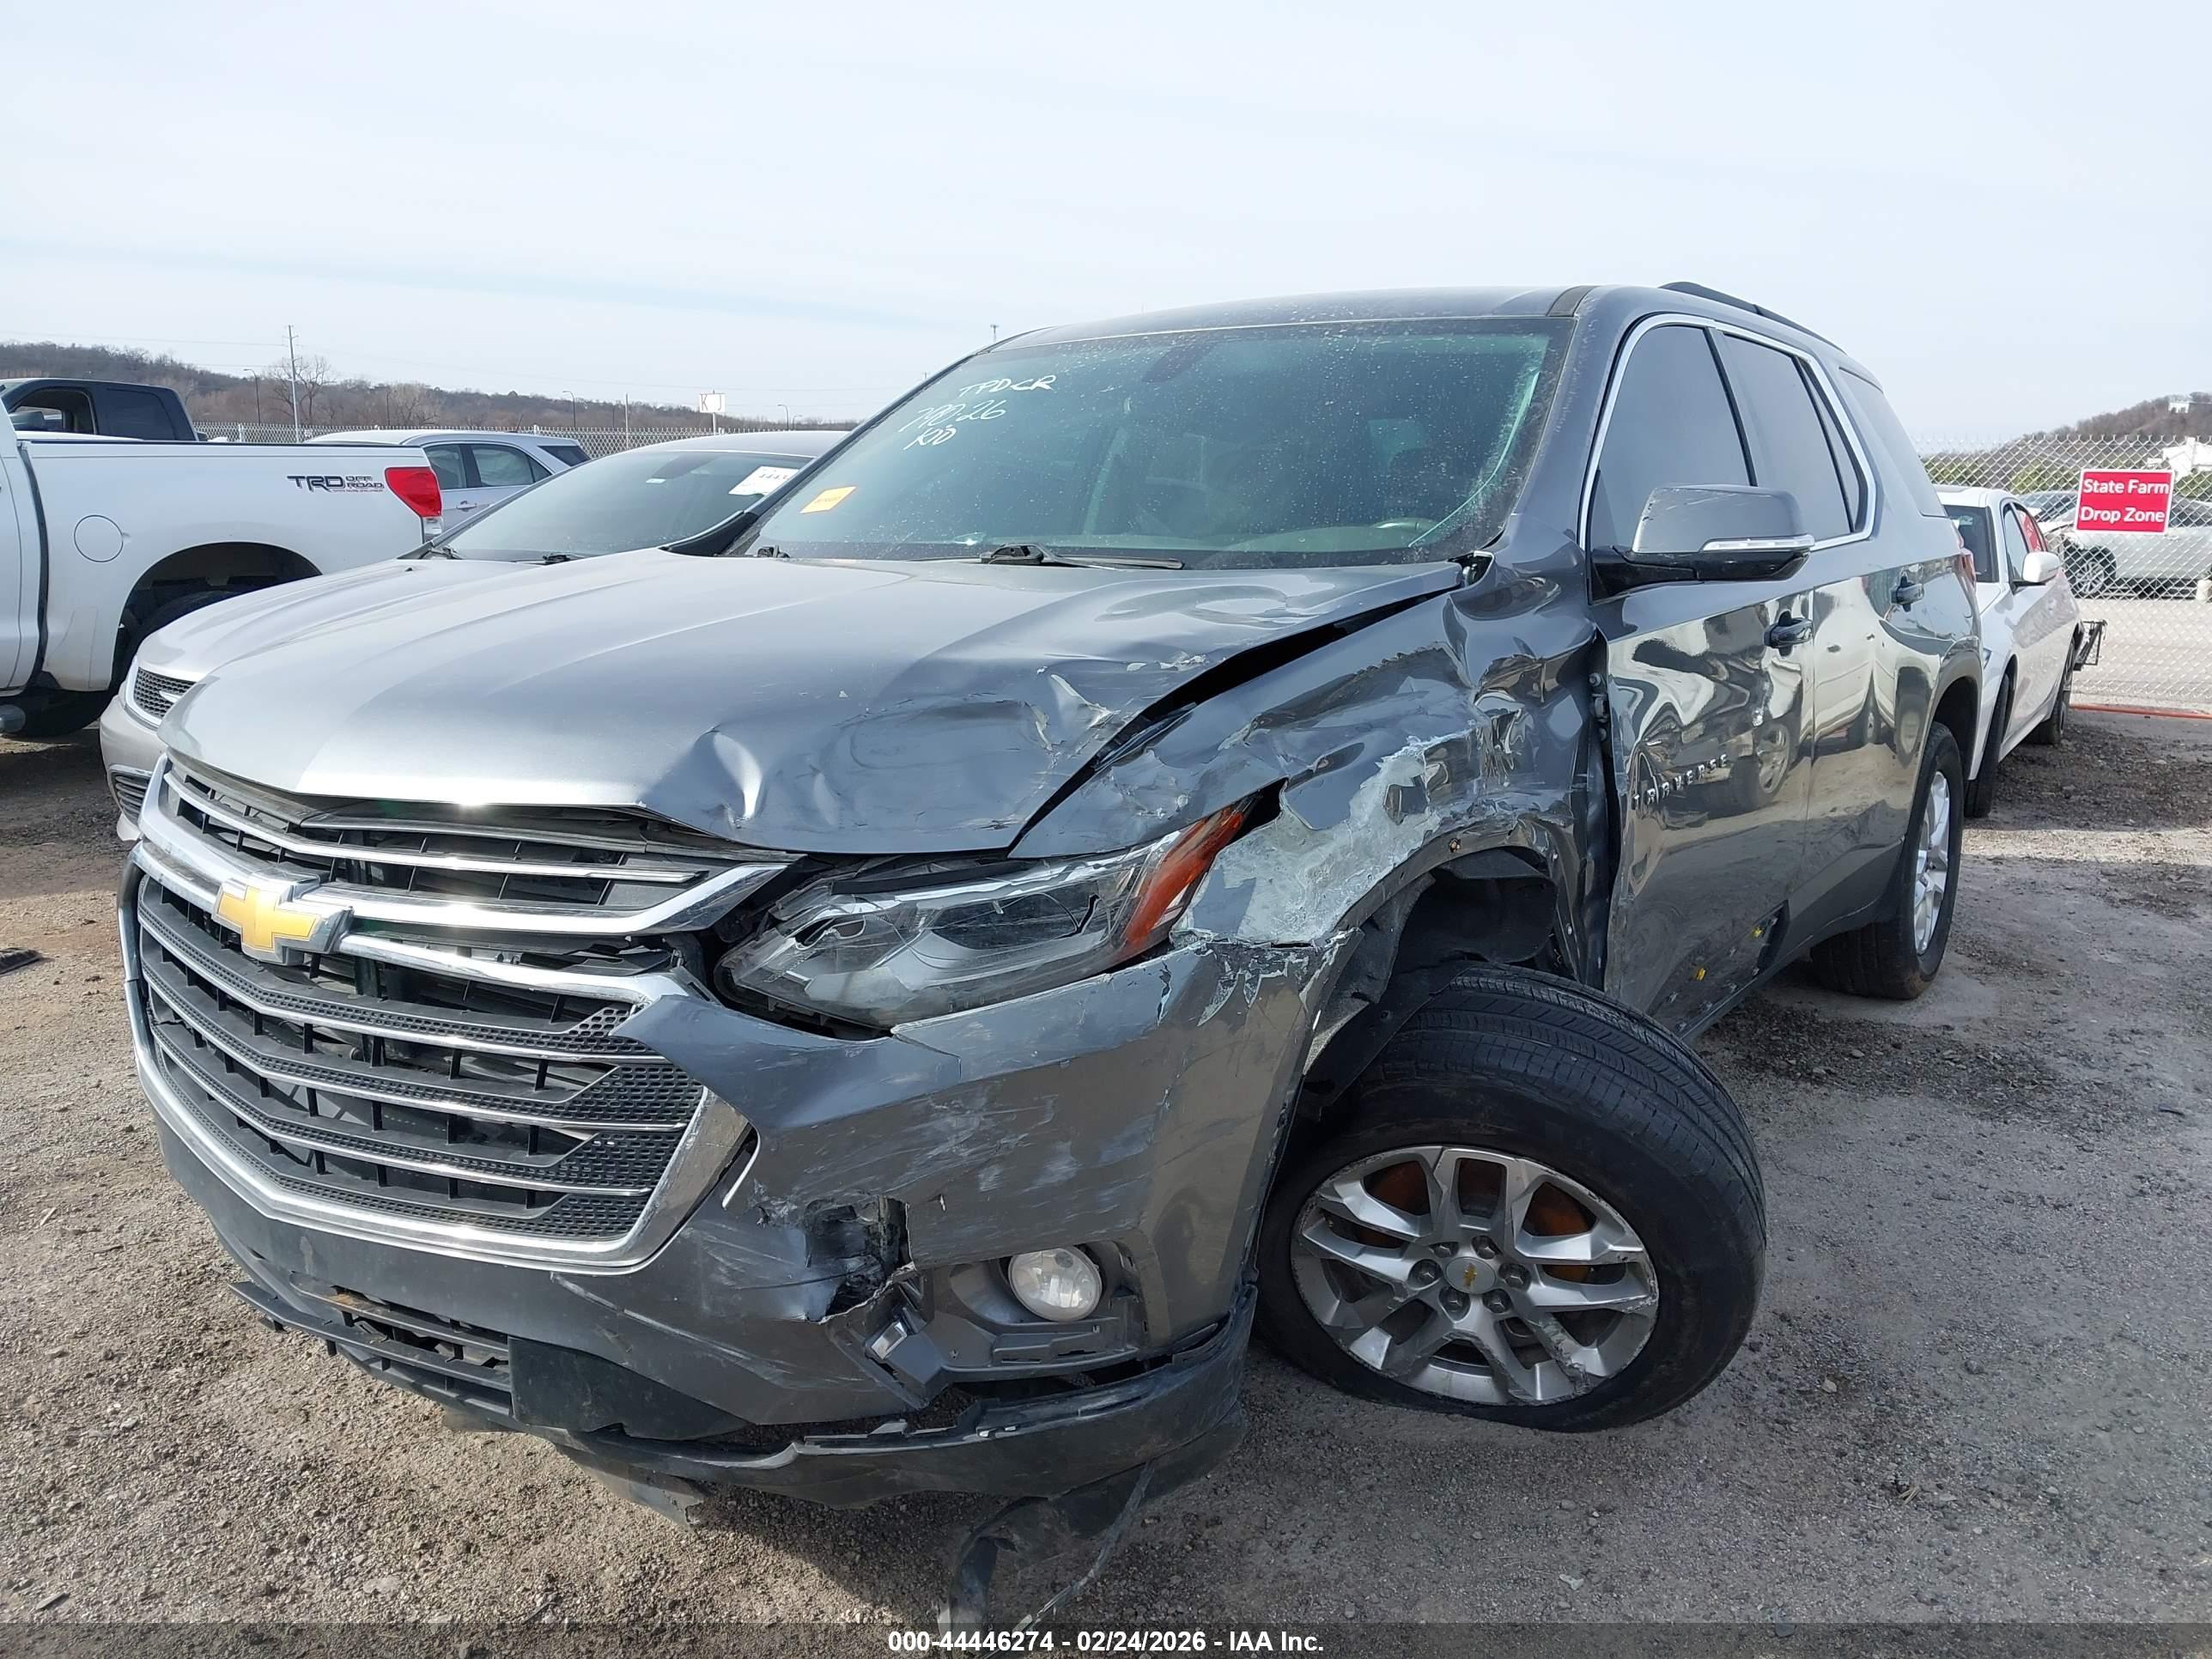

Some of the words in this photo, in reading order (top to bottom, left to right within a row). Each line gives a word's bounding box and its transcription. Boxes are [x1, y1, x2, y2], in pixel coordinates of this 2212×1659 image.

[286, 476, 345, 492] TRD
[2082, 478, 2125, 494] State
[2127, 478, 2170, 495] Farm
[2080, 506, 2122, 524] Drop
[2123, 507, 2166, 522] Zone
